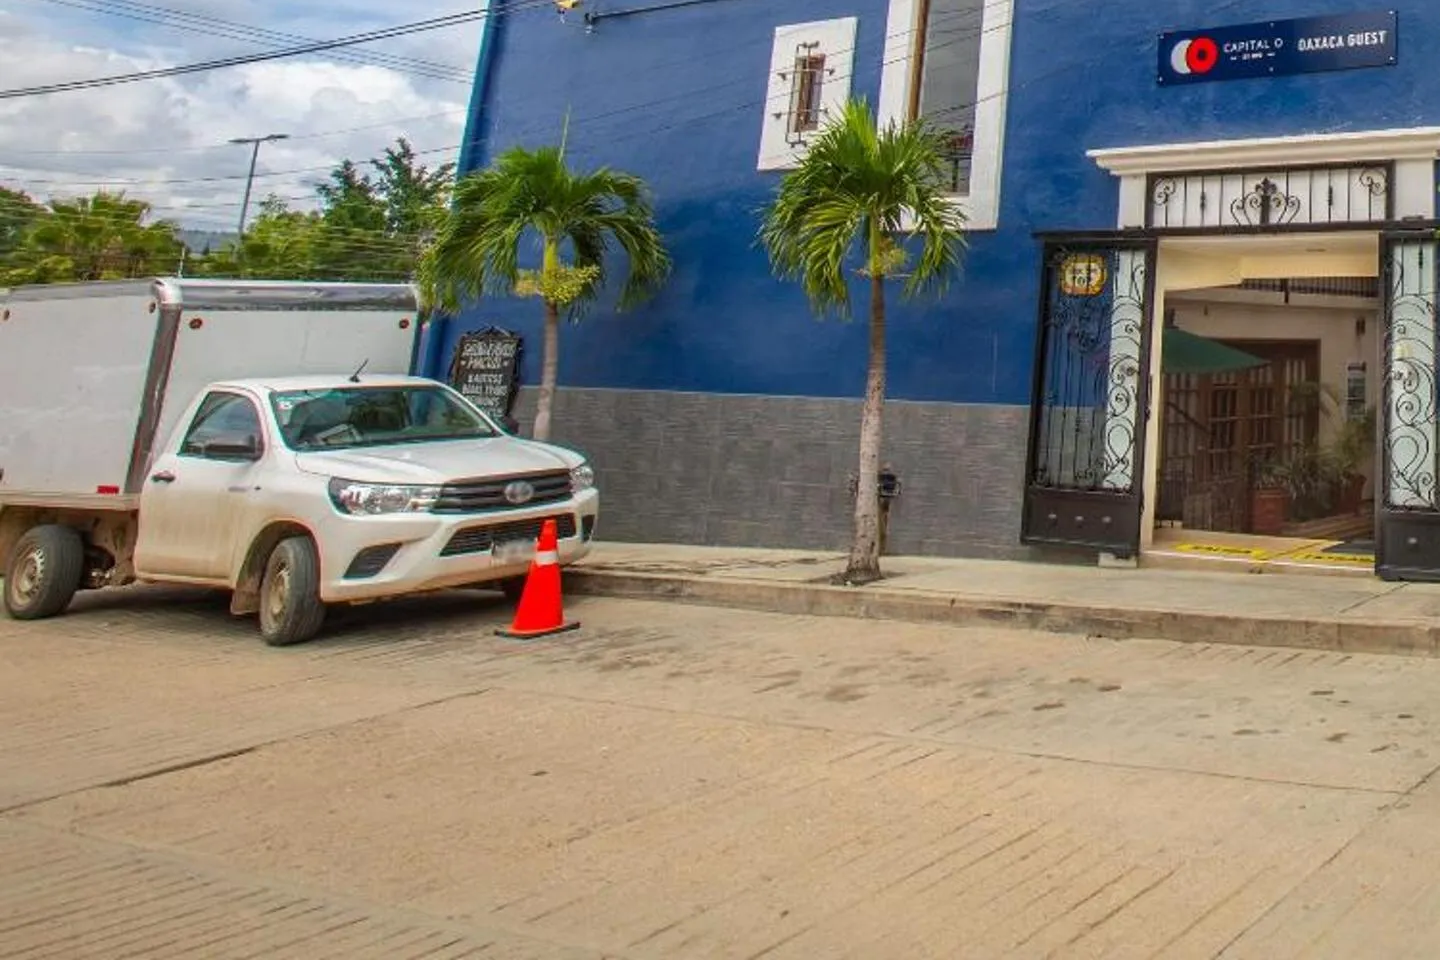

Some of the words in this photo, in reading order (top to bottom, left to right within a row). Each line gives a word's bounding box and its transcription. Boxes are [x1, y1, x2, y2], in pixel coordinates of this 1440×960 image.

[1223, 39, 1270, 53] CAPITAL
[1274, 37, 1284, 49] O
[1297, 35, 1345, 52] OAXACA
[1347, 30, 1387, 48] GUEST
